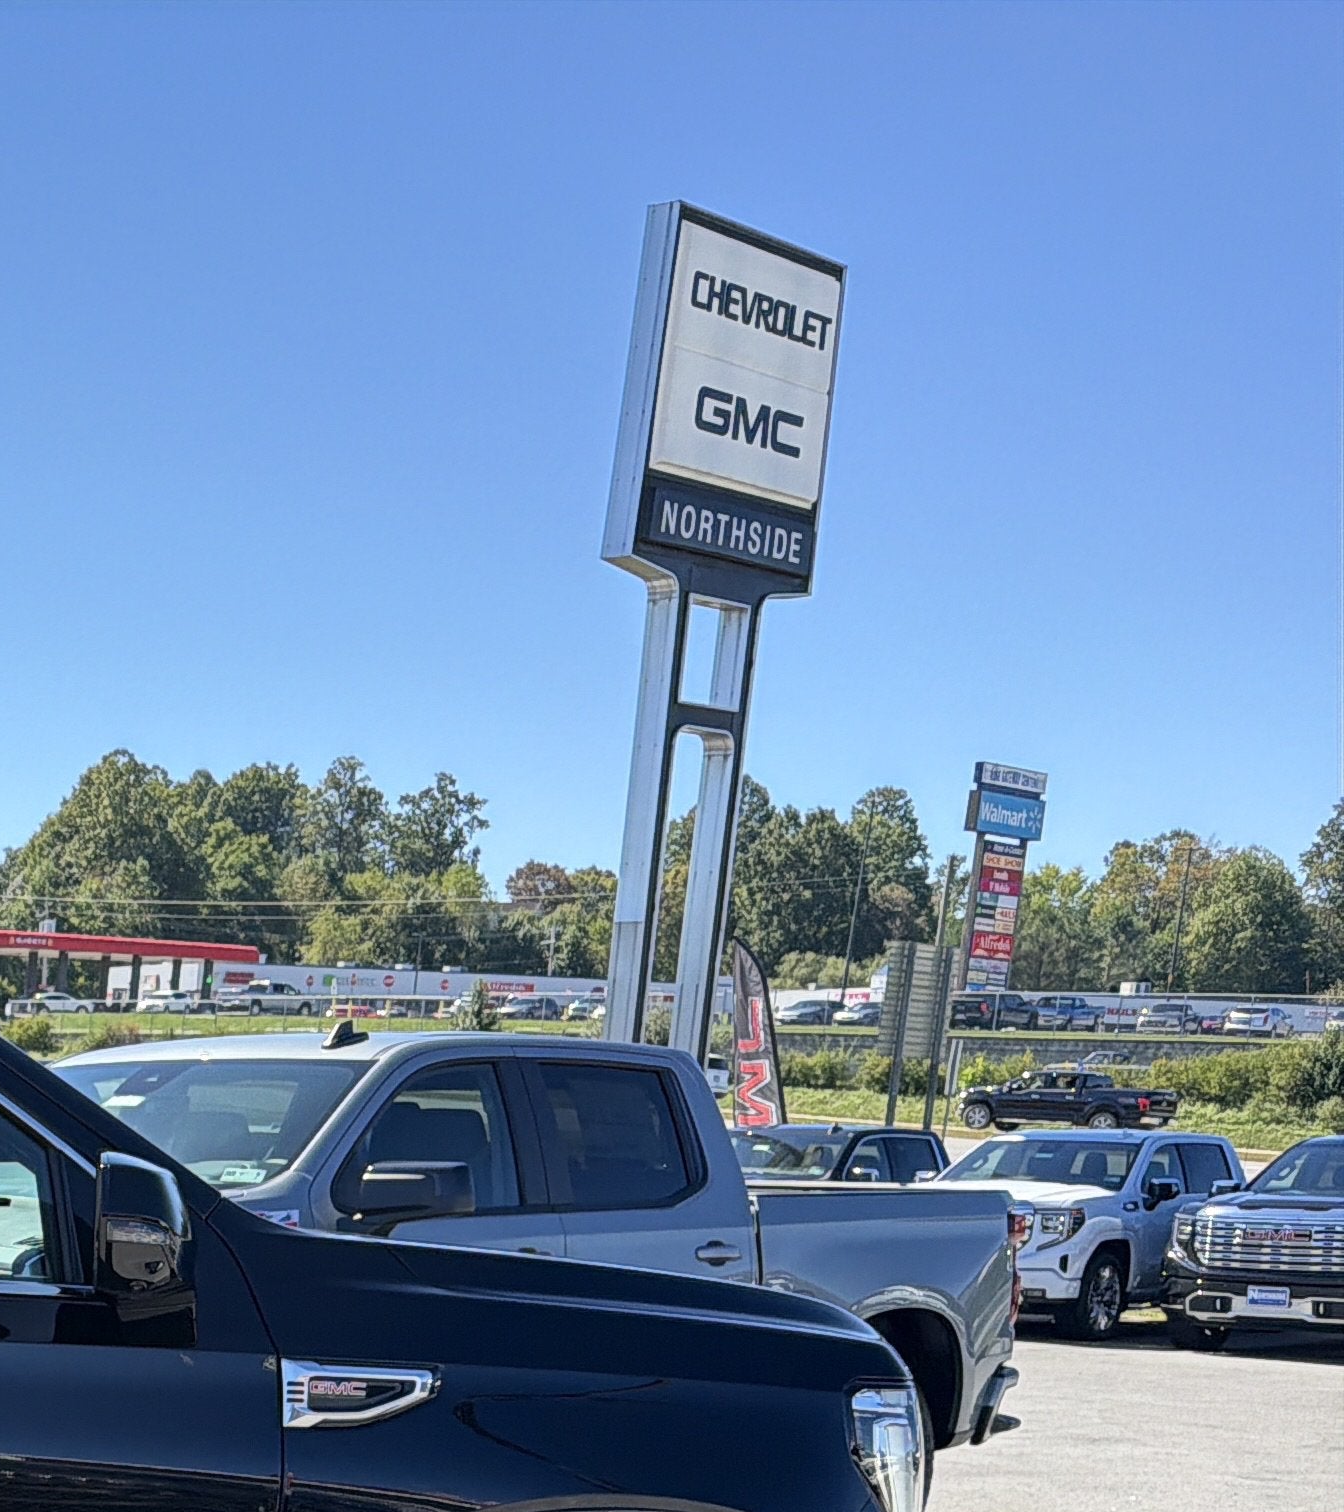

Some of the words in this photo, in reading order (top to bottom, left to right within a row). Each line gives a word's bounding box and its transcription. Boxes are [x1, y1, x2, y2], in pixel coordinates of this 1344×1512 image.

[691, 270, 832, 351] CHEVROLET
[695, 386, 805, 458] GMC
[660, 500, 804, 565] NORTHSIDE
[980, 802, 1028, 828] Walmart
[309, 1381, 367, 1397] GMC
